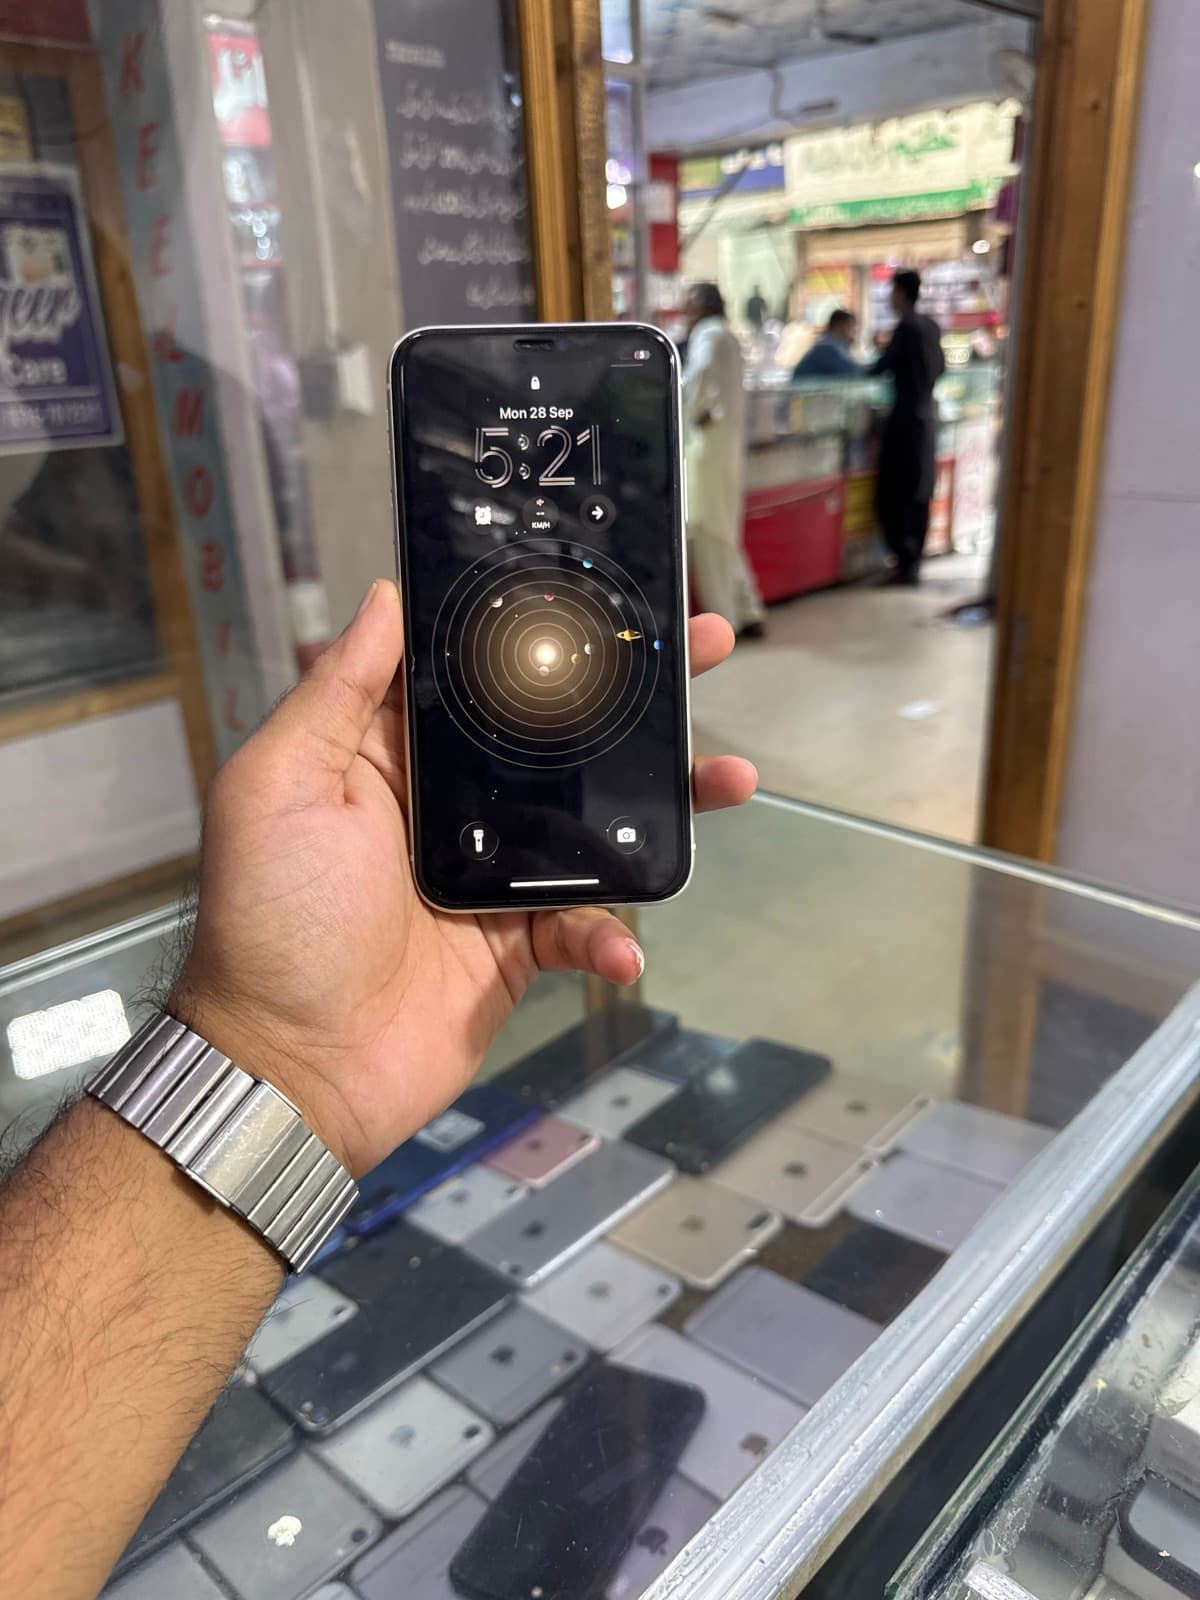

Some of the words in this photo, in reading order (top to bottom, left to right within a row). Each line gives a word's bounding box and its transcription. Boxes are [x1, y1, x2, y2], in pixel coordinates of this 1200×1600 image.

[499, 407, 528, 419] Mon
[529, 406, 547, 419] 28
[549, 406, 574, 420] Sep
[475, 424, 602, 488] 5:21
[531, 521, 551, 530] KM/H
